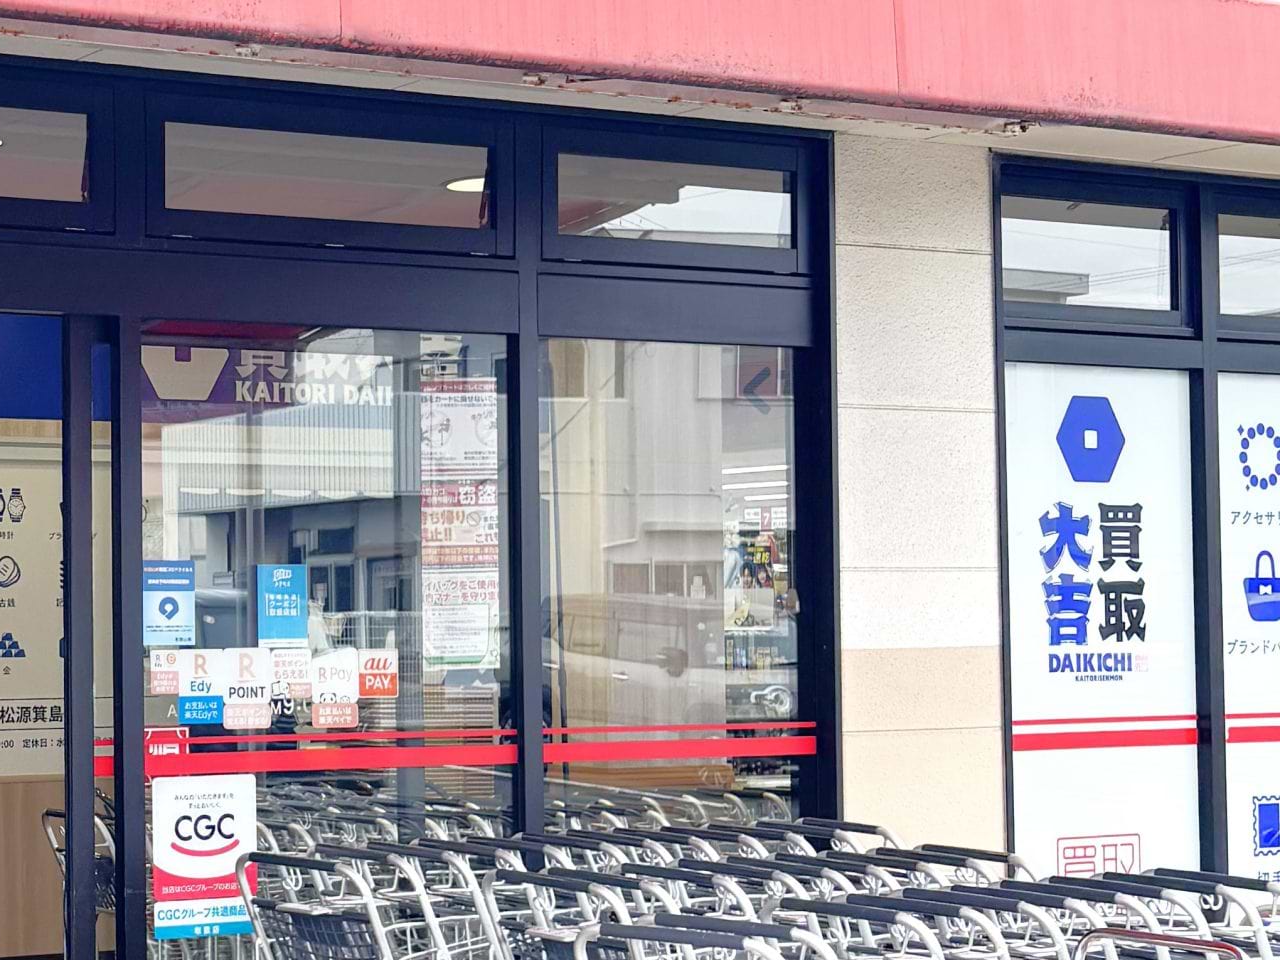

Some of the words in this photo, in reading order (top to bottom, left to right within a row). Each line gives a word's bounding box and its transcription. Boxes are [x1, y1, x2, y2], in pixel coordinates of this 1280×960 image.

[235, 380, 335, 404] KAITORI
[0, 531, 14, 540] 時計
[1038, 501, 1094, 646] 大吉
[1097, 502, 1147, 643] 買取
[194, 654, 208, 675] R
[364, 657, 390, 670] au
[1048, 653, 1133, 673] DAIKICHI
[2, 666, 11, 675] 金
[330, 667, 353, 681] Pay
[190, 680, 212, 693] Edy
[365, 675, 391, 689] PAY
[228, 687, 266, 699] POINT
[174, 813, 235, 841] CGC
